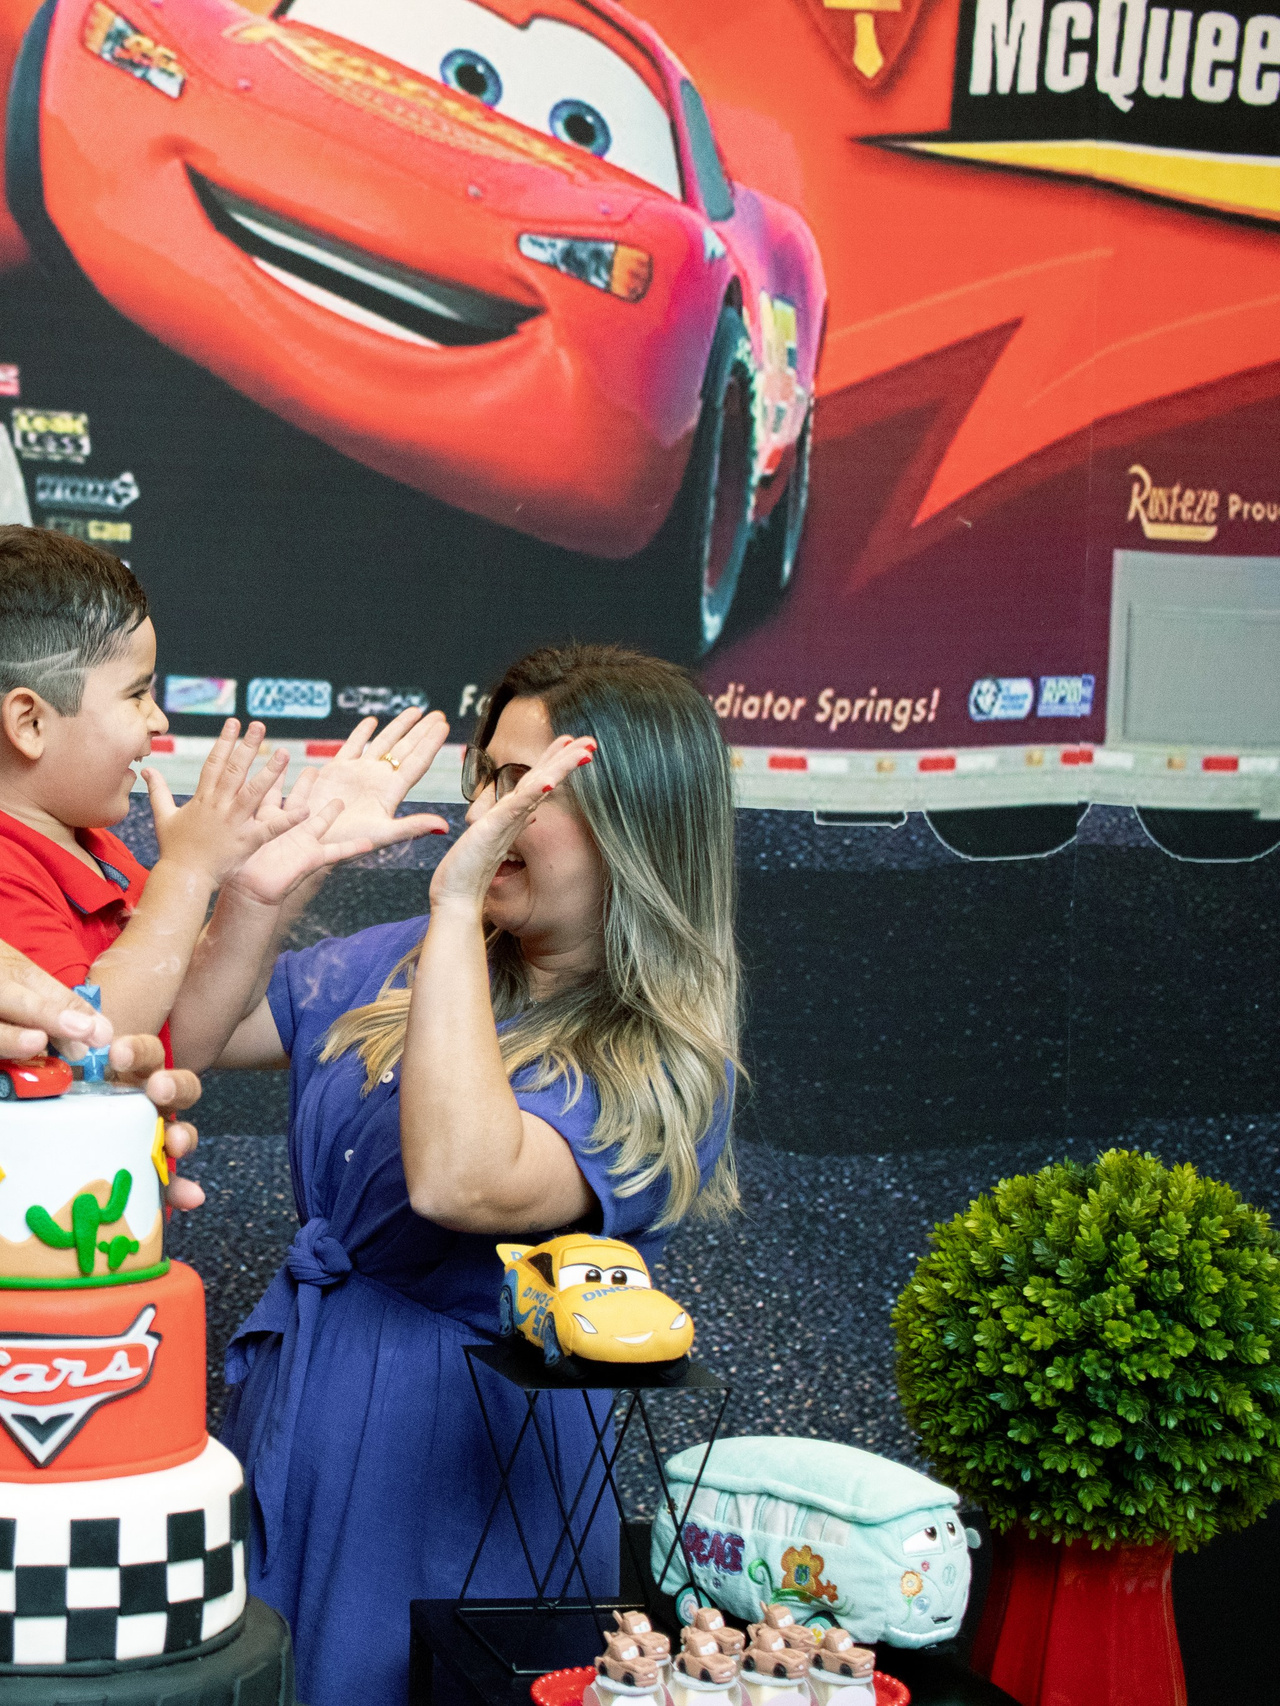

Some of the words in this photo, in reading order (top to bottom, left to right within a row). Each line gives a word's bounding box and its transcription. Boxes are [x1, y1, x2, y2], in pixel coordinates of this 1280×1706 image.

[969, 0, 1280, 113] McQuee
[1228, 493, 1280, 522] Prou
[707, 681, 807, 721] diator
[814, 687, 940, 733] Springs!
[681, 1522, 745, 1576] PEACE
